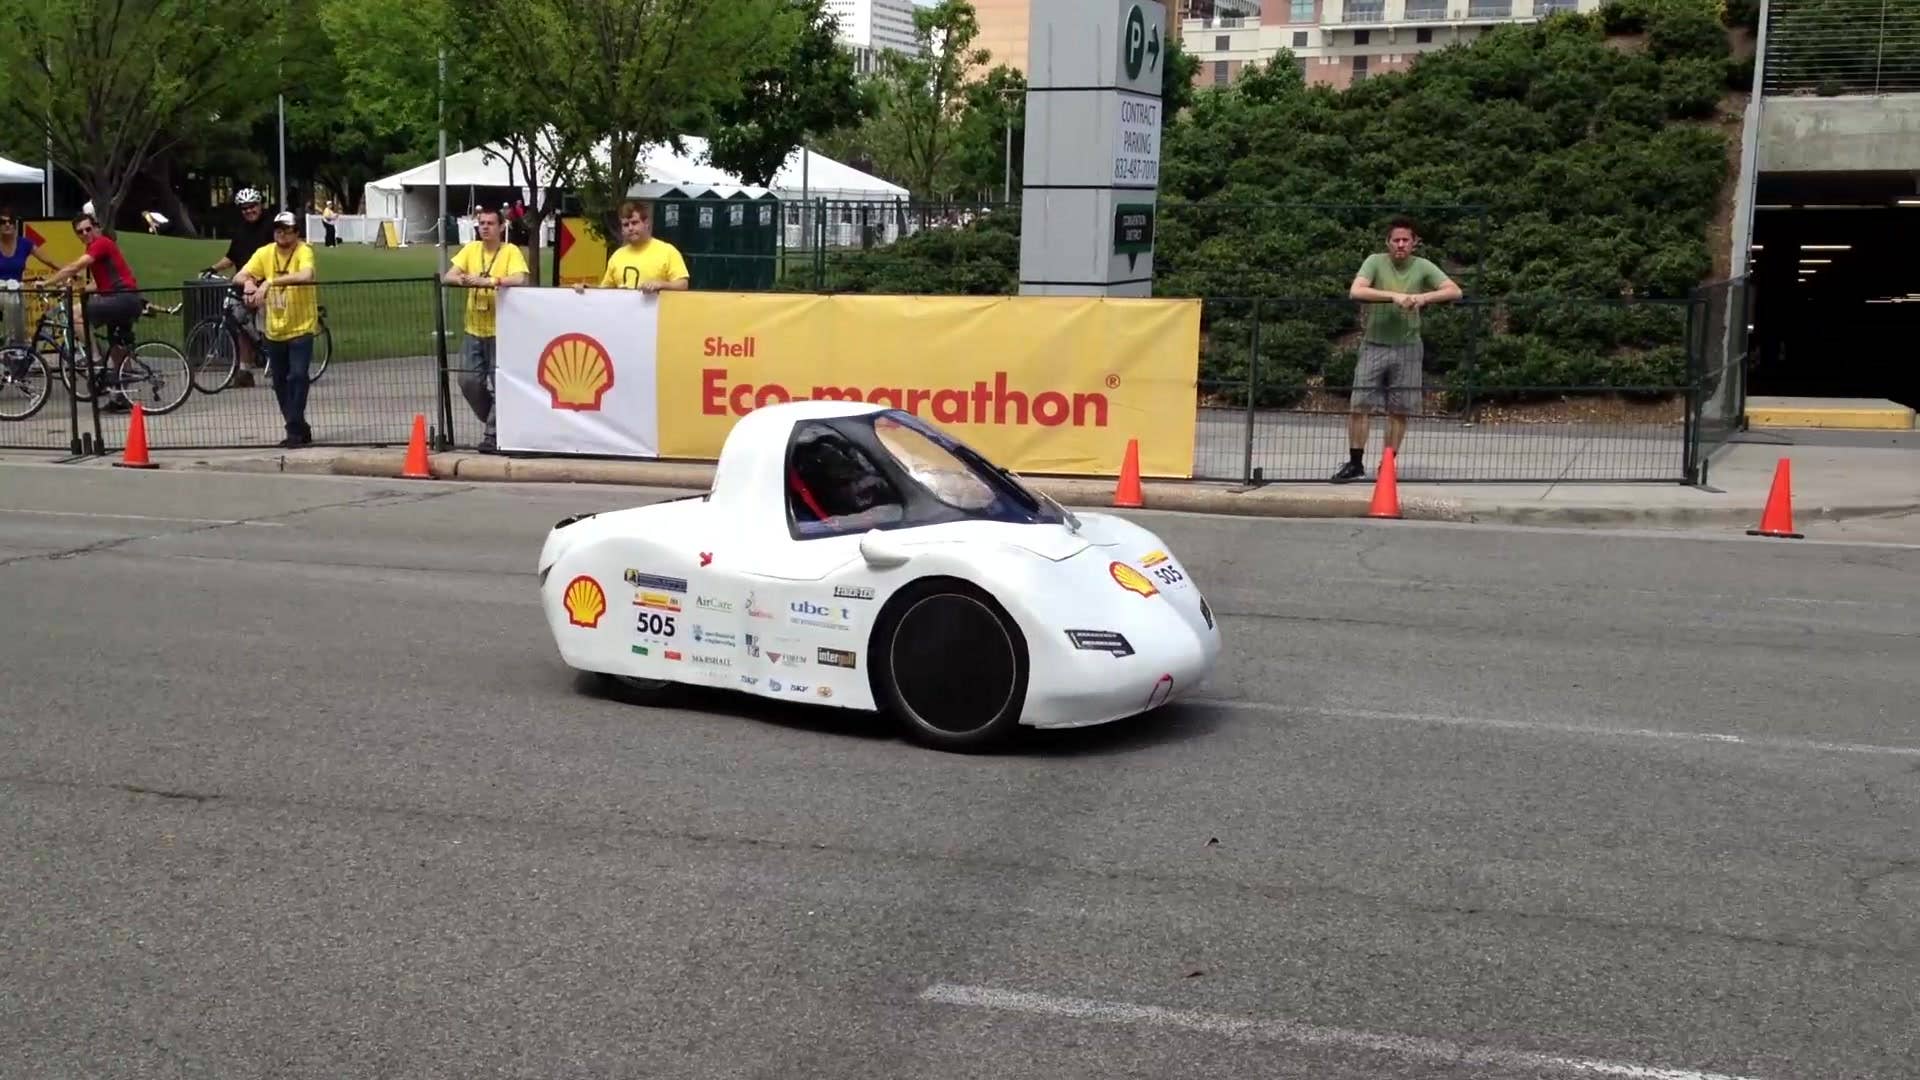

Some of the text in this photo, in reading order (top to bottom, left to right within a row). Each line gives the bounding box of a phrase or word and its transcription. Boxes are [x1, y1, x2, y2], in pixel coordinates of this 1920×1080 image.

[1130, 21, 1142, 63] P
[1121, 100, 1157, 126] CONTRACT
[1123, 131, 1152, 154] PARKING
[704, 336, 755, 358] Shell
[1154, 565, 1183, 585] 505
[695, 595, 733, 610] AirCare
[636, 611, 676, 637] 505
